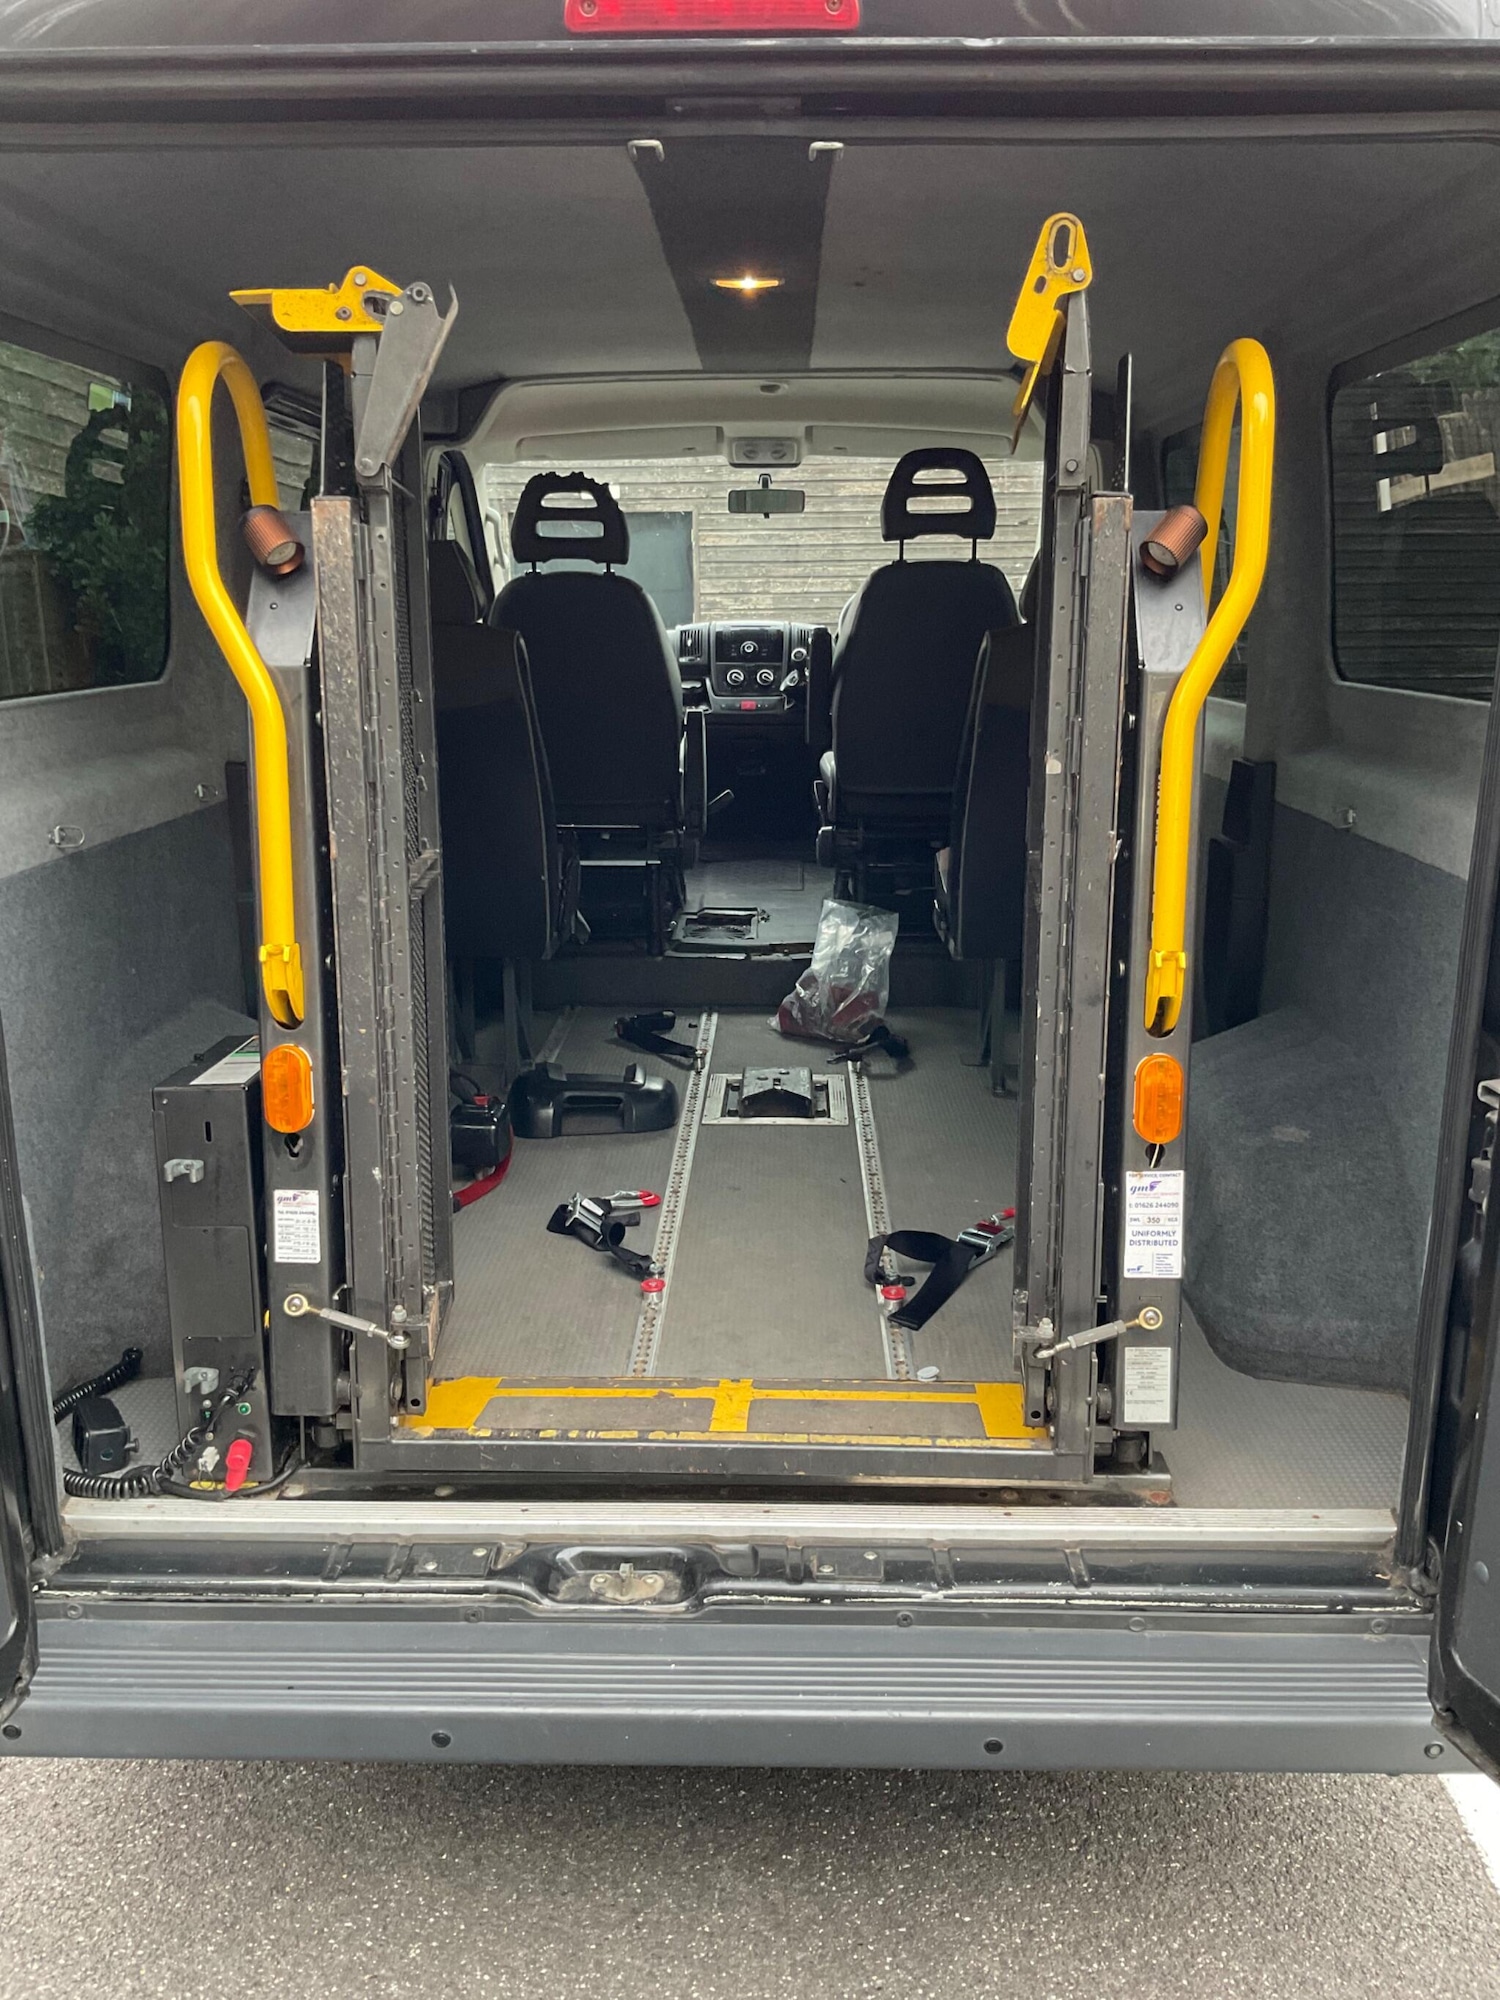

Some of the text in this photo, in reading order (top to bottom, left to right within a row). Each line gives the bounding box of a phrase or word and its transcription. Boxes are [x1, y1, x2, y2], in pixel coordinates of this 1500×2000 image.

[1146, 1216, 1161, 1224] 350
[1131, 1230, 1177, 1238] UNIFORMLY
[1129, 1239, 1179, 1247] DISTRIBUTED
